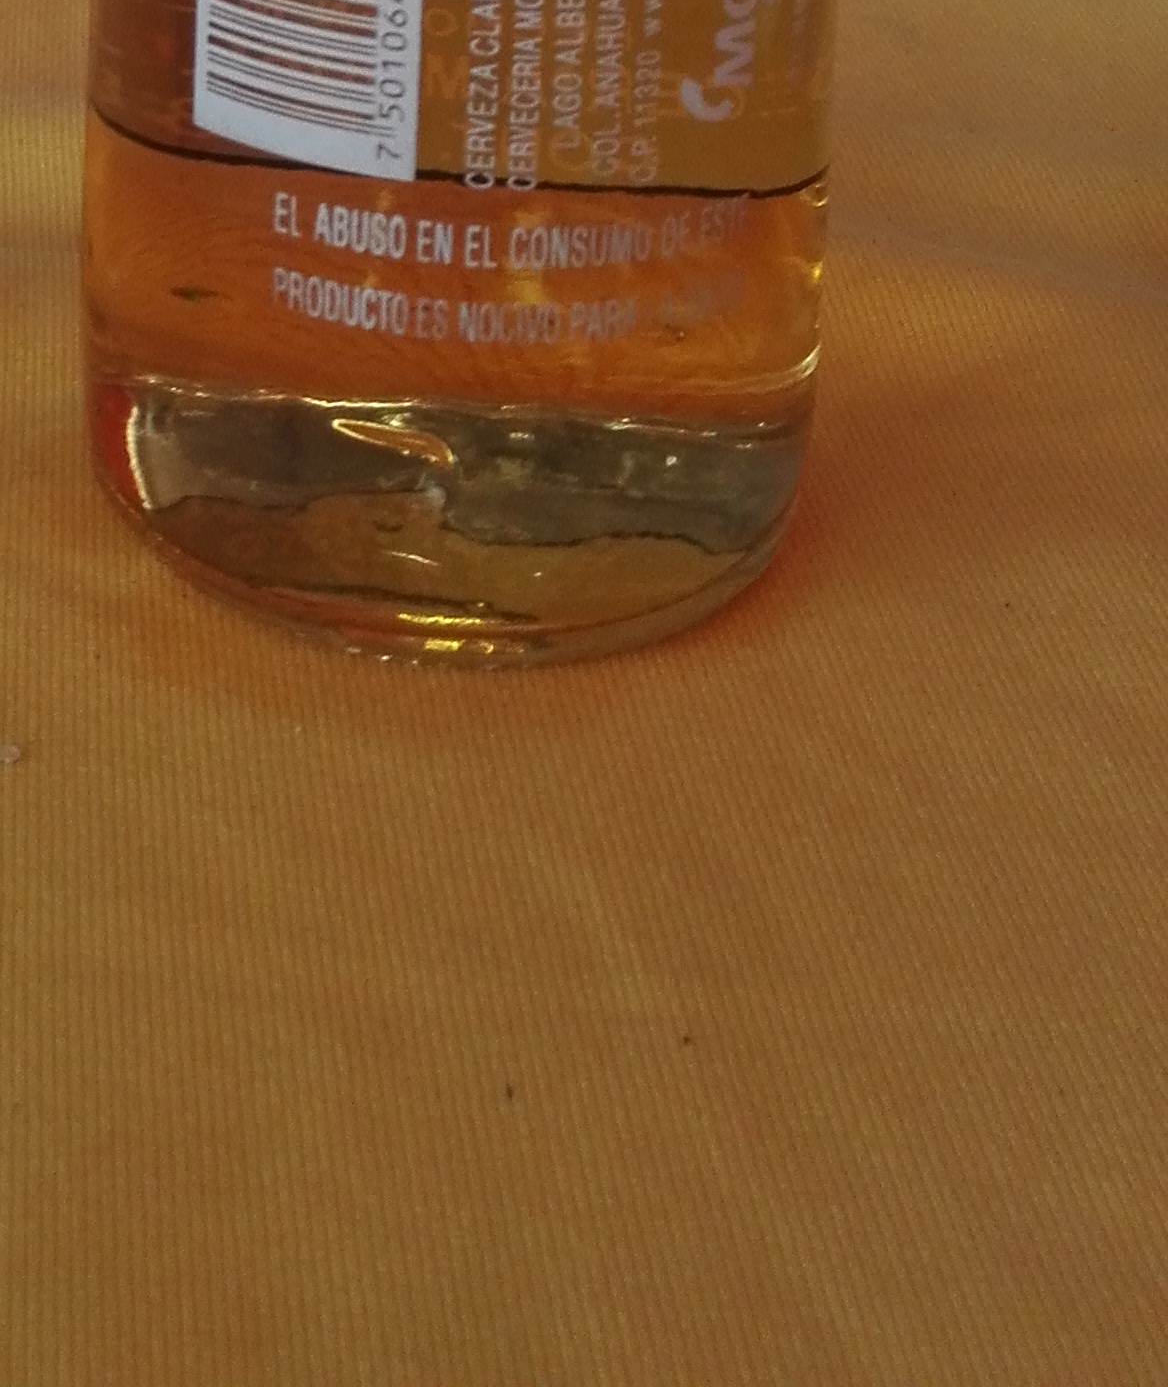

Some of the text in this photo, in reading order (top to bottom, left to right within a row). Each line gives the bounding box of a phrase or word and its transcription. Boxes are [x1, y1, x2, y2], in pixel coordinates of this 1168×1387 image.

[465, 63, 499, 189] CERVEZA
[507, 37, 543, 190] CERVECERIA
[551, 73, 583, 148] LAGO
[273, 190, 302, 239] EL
[314, 201, 408, 260] ABUSO
[415, 218, 453, 267] EN
[464, 225, 499, 270] EL
[508, 225, 649, 271] CONSUMO
[273, 266, 409, 329] PRODUCTO
[416, 299, 449, 341] ES
